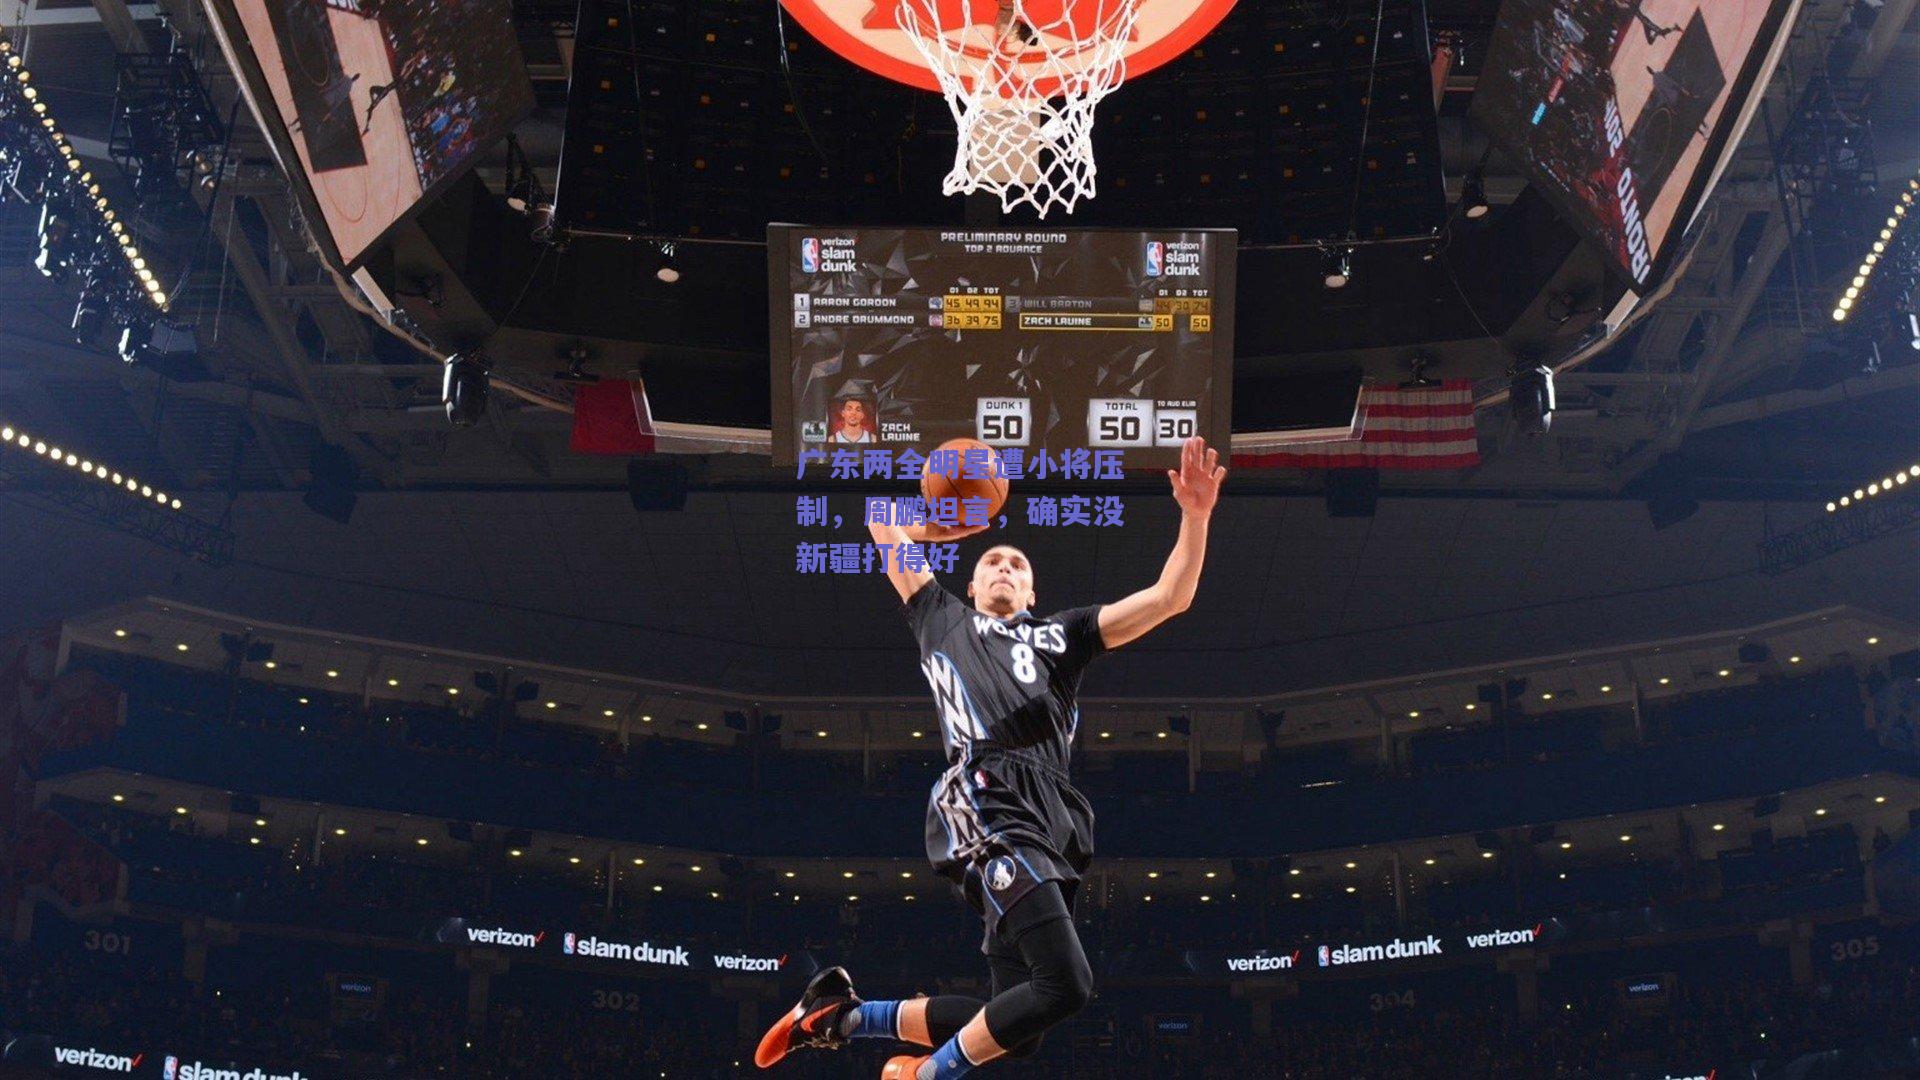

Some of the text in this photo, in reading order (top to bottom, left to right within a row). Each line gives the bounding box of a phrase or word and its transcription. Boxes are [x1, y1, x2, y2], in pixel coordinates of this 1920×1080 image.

[821, 237, 855, 246] verizon
[941, 232, 1067, 243] PRELIMINARY ROUND
[965, 245, 1042, 254] TOP 2 ADVANCE
[1166, 241, 1200, 250] verizon
[821, 246, 855, 259] slam
[1166, 250, 1199, 263] slam
[821, 260, 857, 272] dunk
[1165, 263, 1200, 276] dunk
[813, 298, 850, 307] AARON
[853, 298, 897, 307] GORDON
[946, 299, 960, 308] 45
[966, 299, 980, 308] 49
[984, 299, 999, 308] 94
[799, 315, 806, 324] 2
[814, 315, 849, 324] ANDRE
[853, 315, 914, 324] DRUMMOND
[966, 316, 980, 325] 39
[984, 316, 999, 325] 75
[1024, 317, 1208, 327] ZACH LAVINE 50 50
[986, 402, 1015, 410] DUNK
[1105, 402, 1138, 411] TOTAL
[881, 423, 911, 432] ZACH
[983, 415, 1023, 440] 50
[1100, 416, 1141, 441] 50
[1159, 419, 1193, 438] 30
[881, 433, 921, 441] LAVINE
[1011, 643, 1037, 683] 8
[467, 928, 536, 948] verizon
[1466, 929, 1534, 948] verizon
[577, 936, 690, 967] slam dunk
[1331, 935, 1443, 965] slam dunk
[714, 954, 779, 971] verizon
[1227, 955, 1292, 971] verizon
[55, 1046, 132, 1072] verizon
